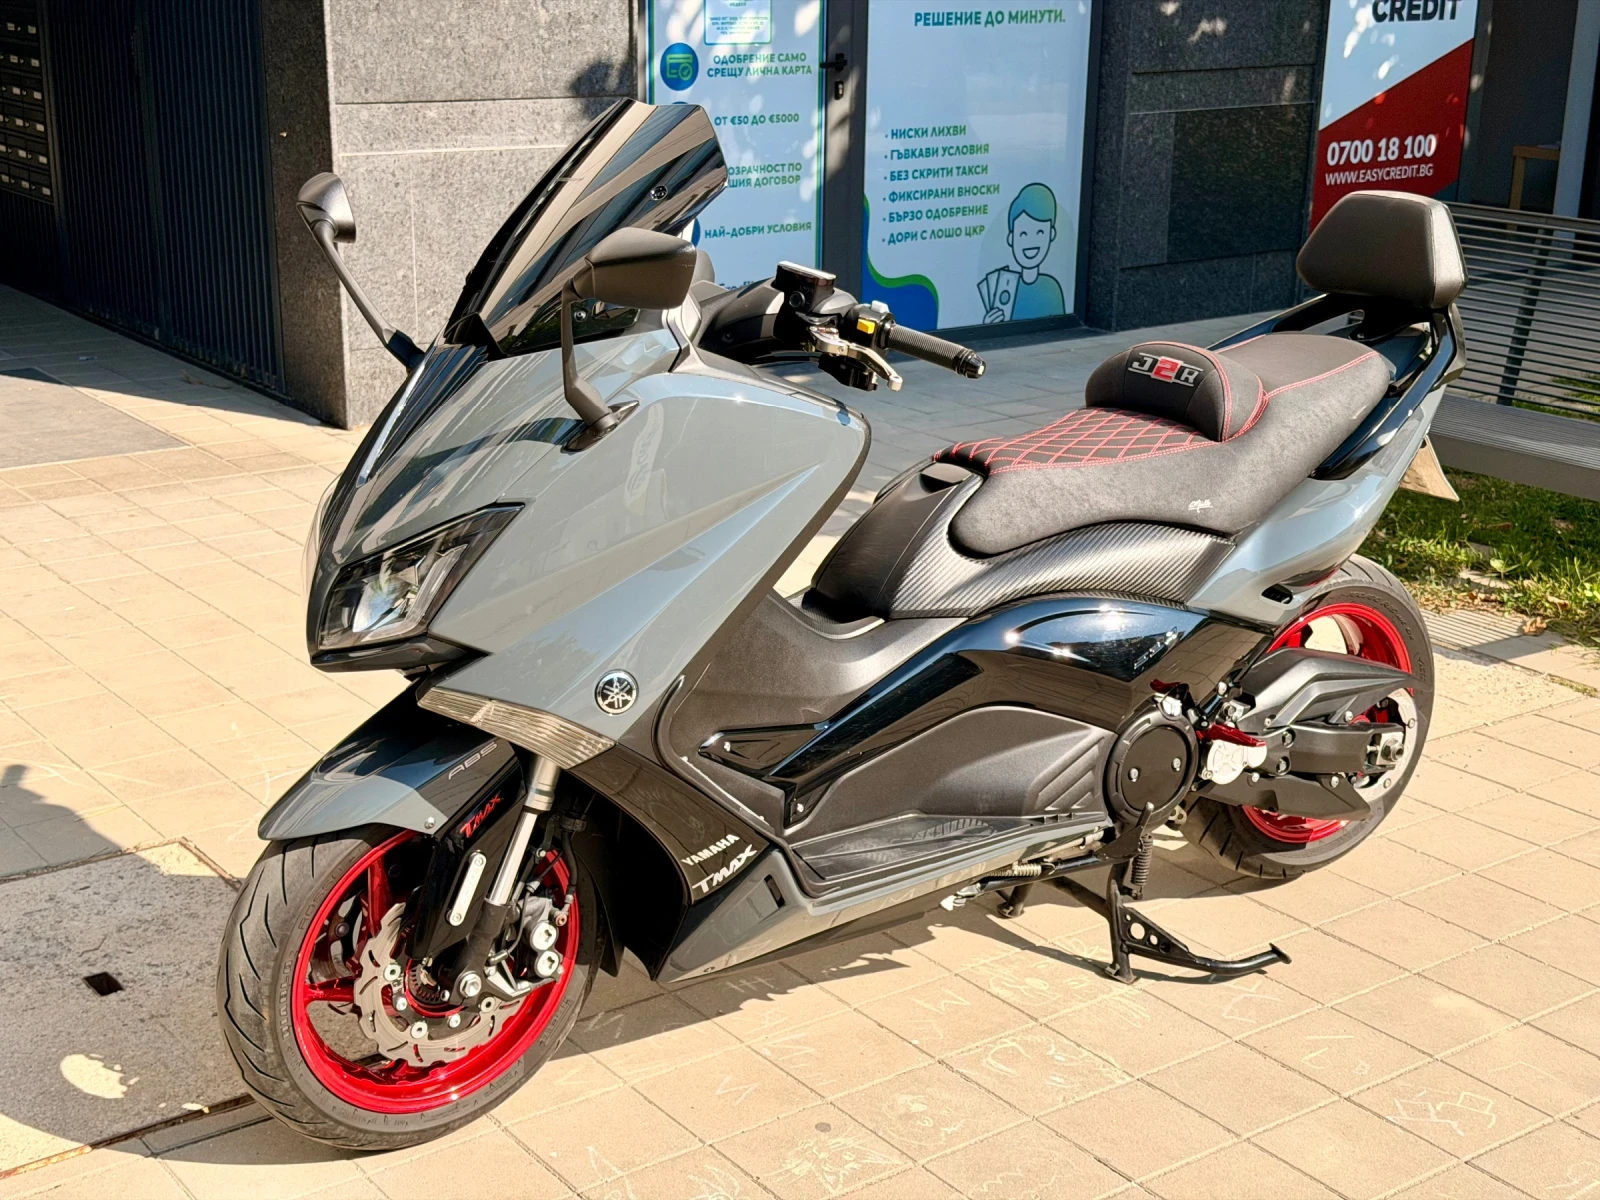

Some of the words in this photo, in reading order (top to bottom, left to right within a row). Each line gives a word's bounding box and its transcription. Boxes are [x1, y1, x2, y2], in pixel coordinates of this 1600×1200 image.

[914, 11, 982, 27] РЕШЕНИЕ
[984, 10, 1004, 28] ДО
[1008, 9, 1066, 24] МИНУТИ.
[1372, 0, 1460, 22] CREDIT
[713, 53, 775, 65] ОДОБРЕНИЕ
[778, 52, 807, 63] САМО
[707, 67, 744, 78] СРЕЩУ
[745, 66, 779, 77] ЛИЧНА
[782, 65, 812, 75] КАРТА
[714, 116, 727, 126] ОТ
[730, 115, 749, 125] €50
[751, 114, 766, 126] ДО
[768, 113, 800, 124] €5000
[891, 126, 929, 140] НИСКИ
[930, 125, 967, 137] ЛИХВИ
[890, 147, 939, 160] ГЪВКАВИ
[941, 144, 990, 158] УСЛОВИЯ
[1327, 139, 1373, 166] 0700
[1377, 136, 1399, 162] 18
[1403, 134, 1437, 159] 100
[728, 164, 786, 176] ОЗРАЧНОСТ
[788, 162, 803, 172] ПО
[889, 170, 909, 182] БЕЗ
[911, 167, 953, 180] СКРИТИ
[955, 165, 989, 177] ТАКСИ
[1325, 163, 1434, 186] WWW.EASYCREDIT.BG
[729, 178, 752, 188] ШИЯ
[754, 175, 801, 188] ДОГОВОР
[888, 187, 955, 204] ФИКСИРАНИ
[957, 184, 1000, 197] ВНОСКИ
[888, 210, 923, 223] БЪРЗО
[925, 205, 989, 220] ОДОБРЕНИЕ
[704, 225, 765, 238] НАЙ-ДОБРИ
[767, 222, 812, 235] УСЛОВИЯ
[888, 231, 918, 245] ДОРИ
[920, 230, 928, 240] С
[929, 227, 962, 240] ЛОШО
[964, 225, 985, 237] ЦКР
[448, 741, 498, 780] ABS
[681, 834, 740, 866] YAMAHA
[691, 843, 758, 894] TMAX
